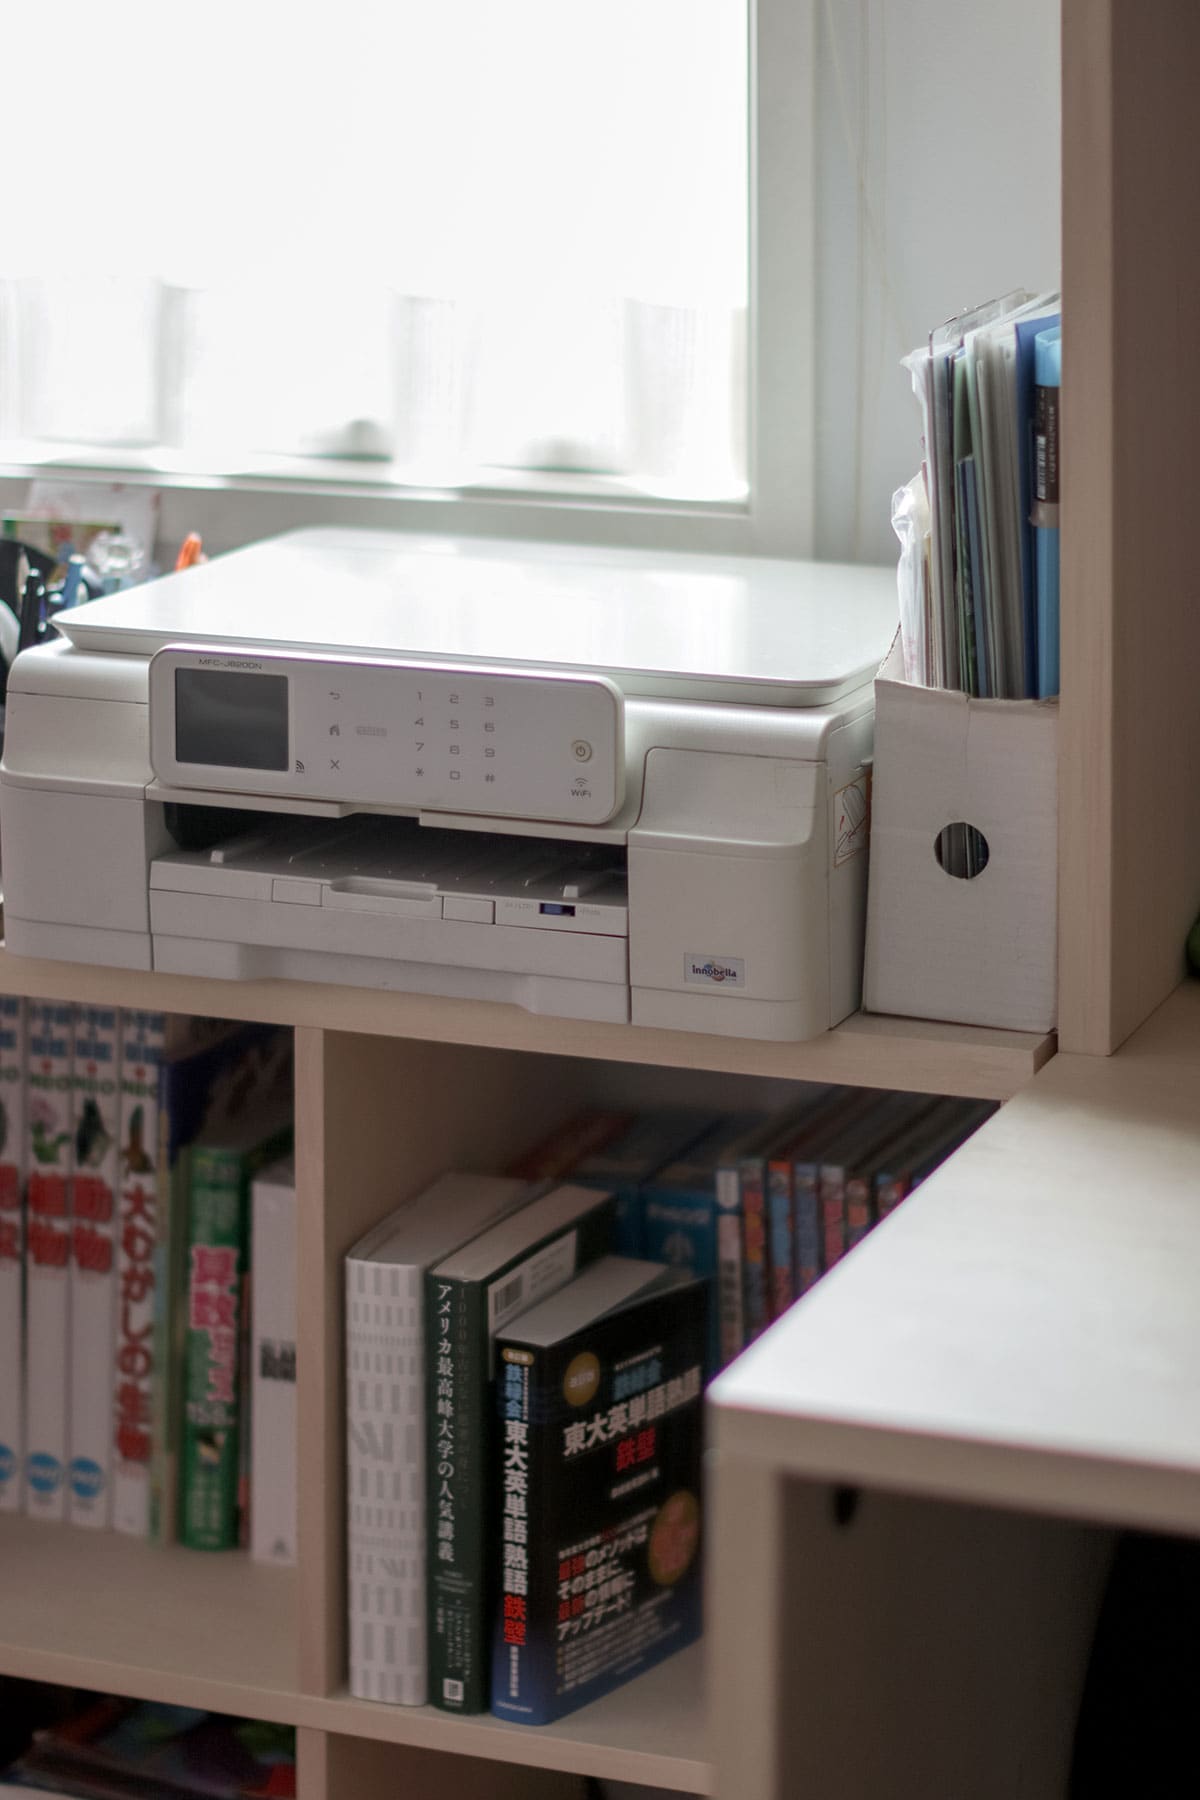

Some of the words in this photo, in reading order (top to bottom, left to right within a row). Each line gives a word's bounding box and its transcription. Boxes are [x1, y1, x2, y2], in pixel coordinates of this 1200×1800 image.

[448, 694, 460, 704] 2
[484, 696, 495, 707] 3
[415, 717, 424, 727] 4
[449, 719, 460, 729] 5
[484, 722, 496, 732] 6
[415, 742, 425, 752] 7
[484, 748, 496, 758] 9
[570, 789, 592, 799] WiFi
[692, 964, 737, 978] innobella
[437, 1283, 456, 1563] アメリカ最高峰大学の人気講義
